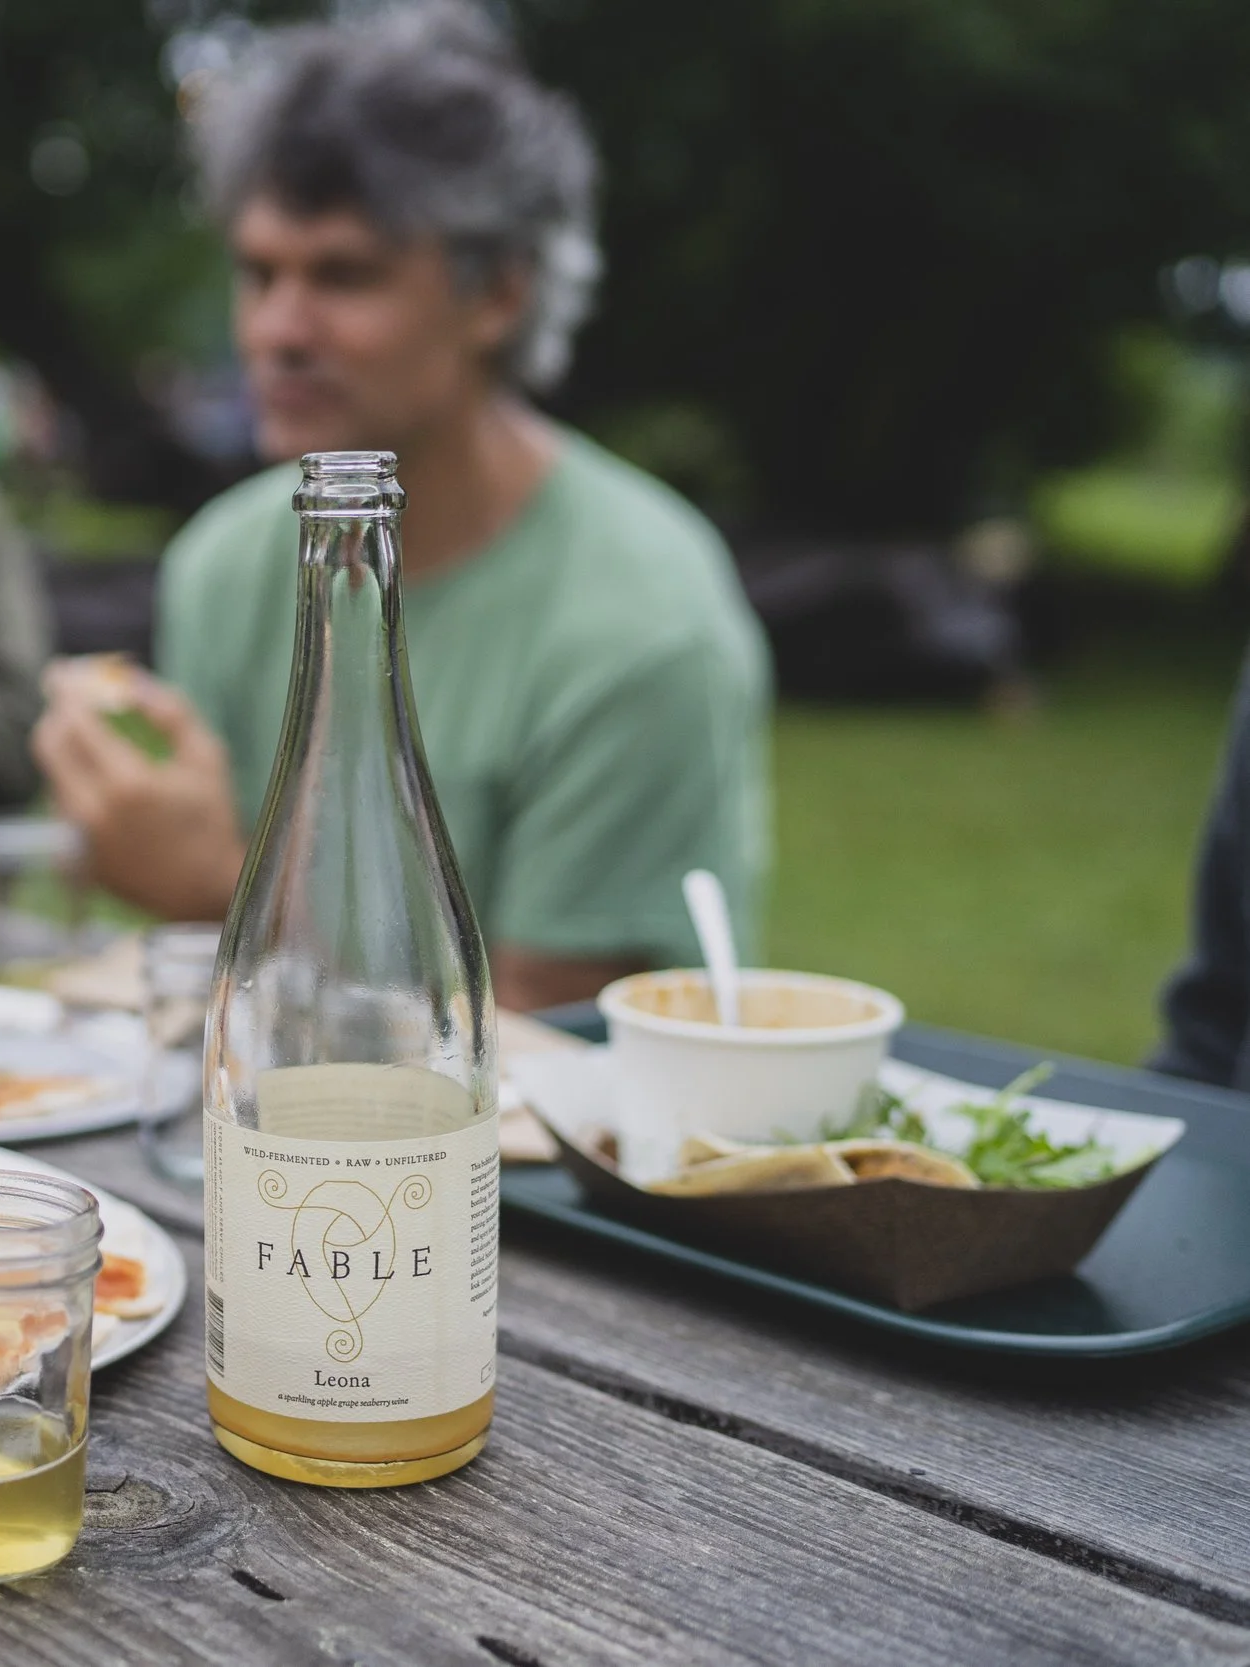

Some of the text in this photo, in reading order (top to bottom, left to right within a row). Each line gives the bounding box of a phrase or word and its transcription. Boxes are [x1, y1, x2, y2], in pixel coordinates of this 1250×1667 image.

[244, 1146, 447, 1167] WILD-FERMENTED RAW UNFILTERED
[257, 1241, 433, 1280] FABLE
[314, 1370, 371, 1388] Leona
[284, 1394, 316, 1407] sparkling
[316, 1397, 338, 1407] apple
[338, 1400, 359, 1409] grape
[360, 1397, 390, 1408] seaberry
[392, 1397, 409, 1405] wine
